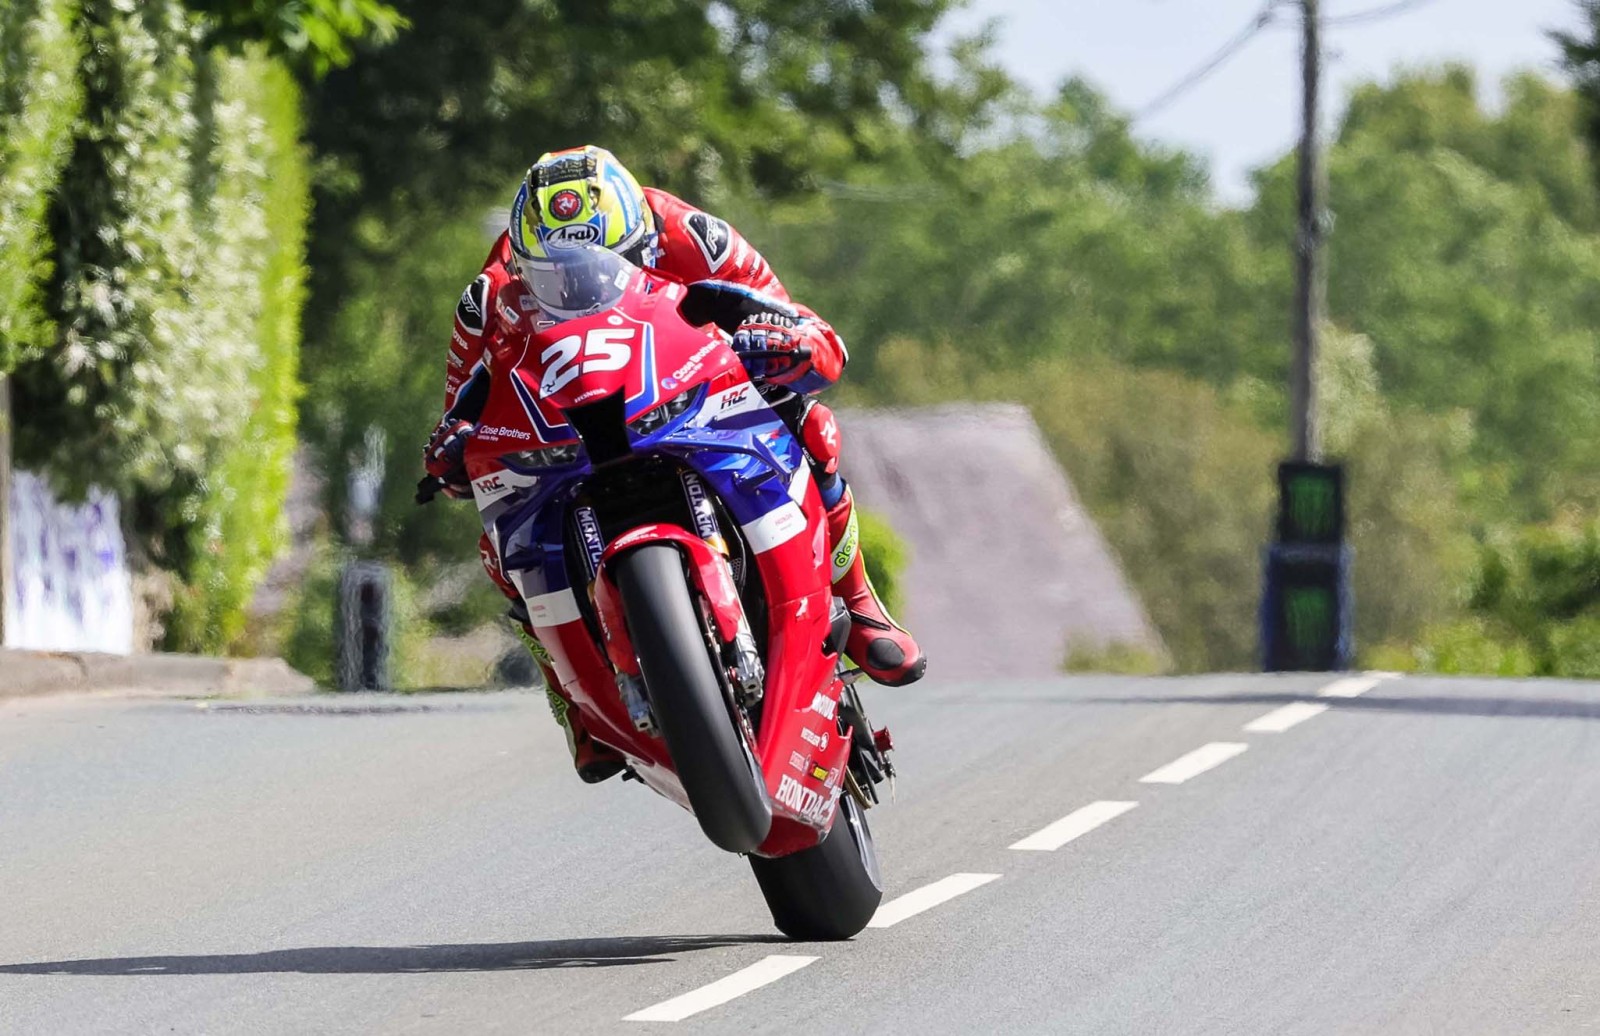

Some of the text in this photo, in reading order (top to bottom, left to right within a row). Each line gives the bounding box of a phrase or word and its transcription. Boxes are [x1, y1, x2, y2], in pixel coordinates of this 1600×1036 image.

[557, 224, 592, 241] Arai
[540, 328, 635, 399] 25
[672, 361, 695, 380] Close
[574, 388, 607, 404] HONDA
[720, 386, 750, 410] HRC
[480, 425, 532, 441] Close Brothers
[476, 476, 505, 494] HRC
[684, 472, 715, 538] MAXTON
[578, 509, 603, 568] MAXTO
